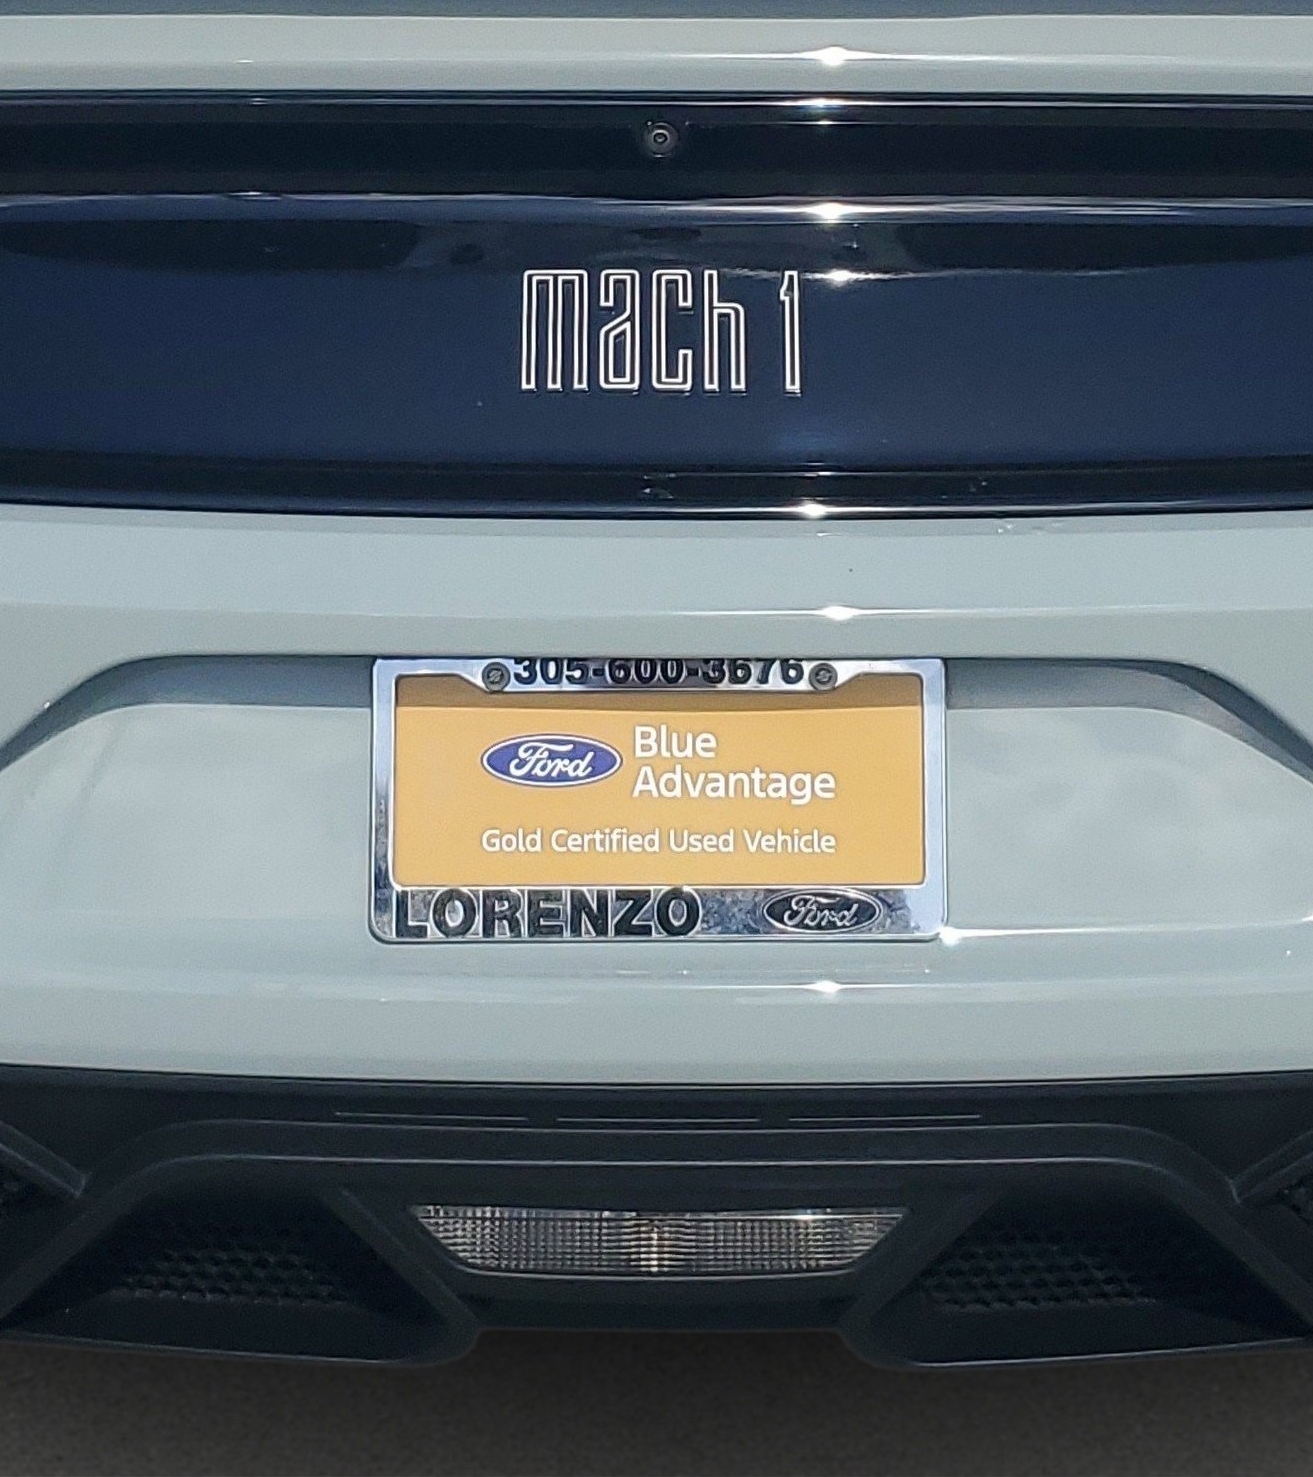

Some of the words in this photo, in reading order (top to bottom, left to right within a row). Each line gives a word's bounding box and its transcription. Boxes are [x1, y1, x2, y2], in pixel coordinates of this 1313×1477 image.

[779, 270, 802, 394] 1
[513, 658, 805, 686] 305-600-3676
[507, 740, 595, 779] Ford
[633, 724, 717, 760] Blue
[632, 765, 837, 806] Advantage
[481, 828, 542, 854] Gold
[550, 827, 660, 854] Certified
[669, 827, 735, 854] Used
[742, 827, 837, 854] Vehicle
[393, 888, 702, 938] LORENZO
[784, 894, 858, 928] Ford
